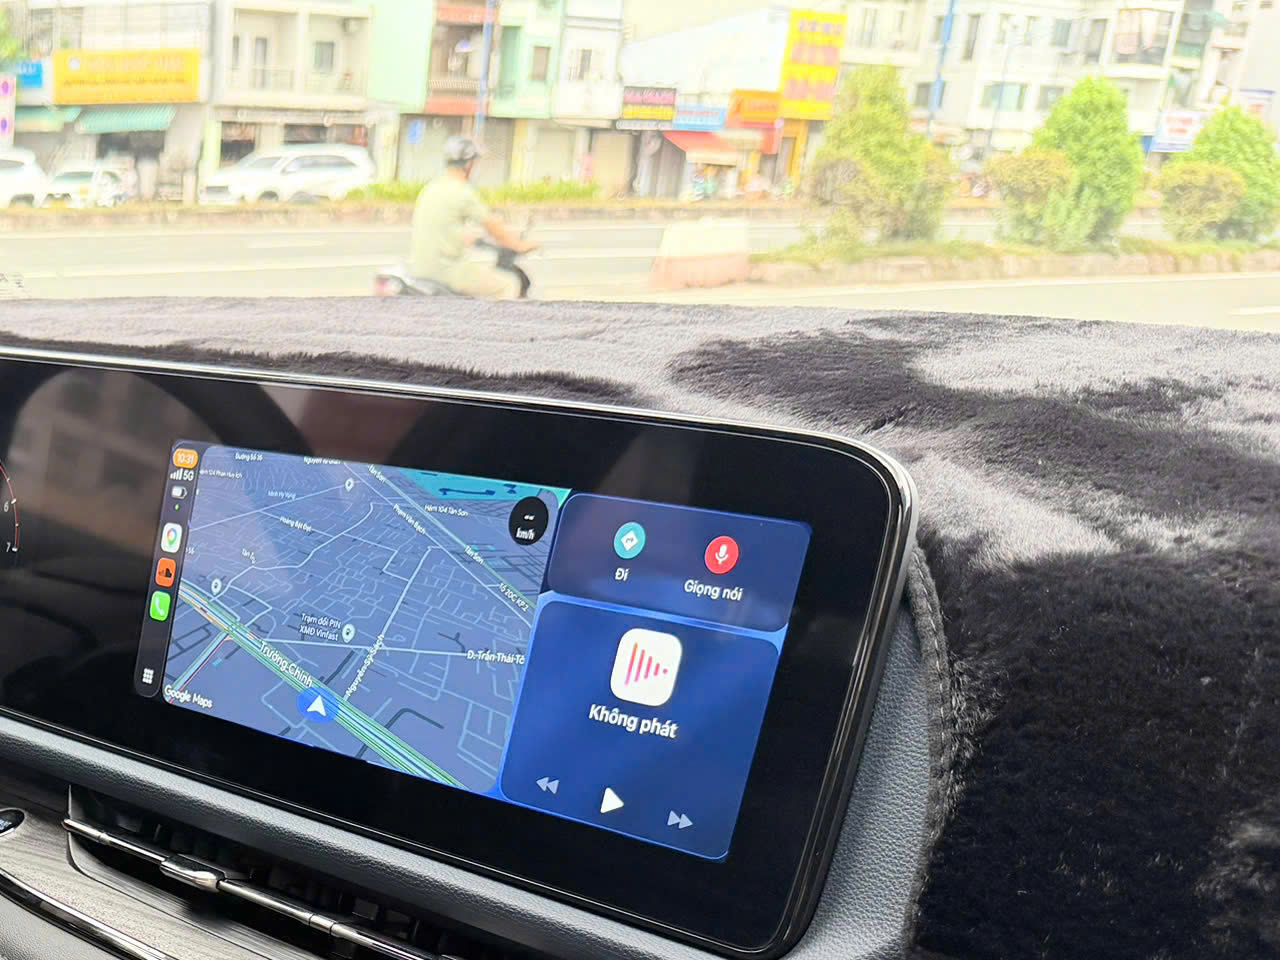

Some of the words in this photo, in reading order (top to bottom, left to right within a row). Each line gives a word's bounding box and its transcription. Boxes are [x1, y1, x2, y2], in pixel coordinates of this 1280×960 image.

[183, 470, 195, 481] 5G
[515, 526, 535, 540] km/h
[615, 567, 629, 581] Đi
[684, 579, 722, 600] Giọng
[722, 587, 744, 601] nói
[301, 612, 317, 624] Trạm
[329, 618, 342, 629] PIN
[164, 684, 191, 703] Google
[192, 693, 213, 708] Maps
[588, 703, 638, 733] Không
[638, 717, 680, 739] phát
